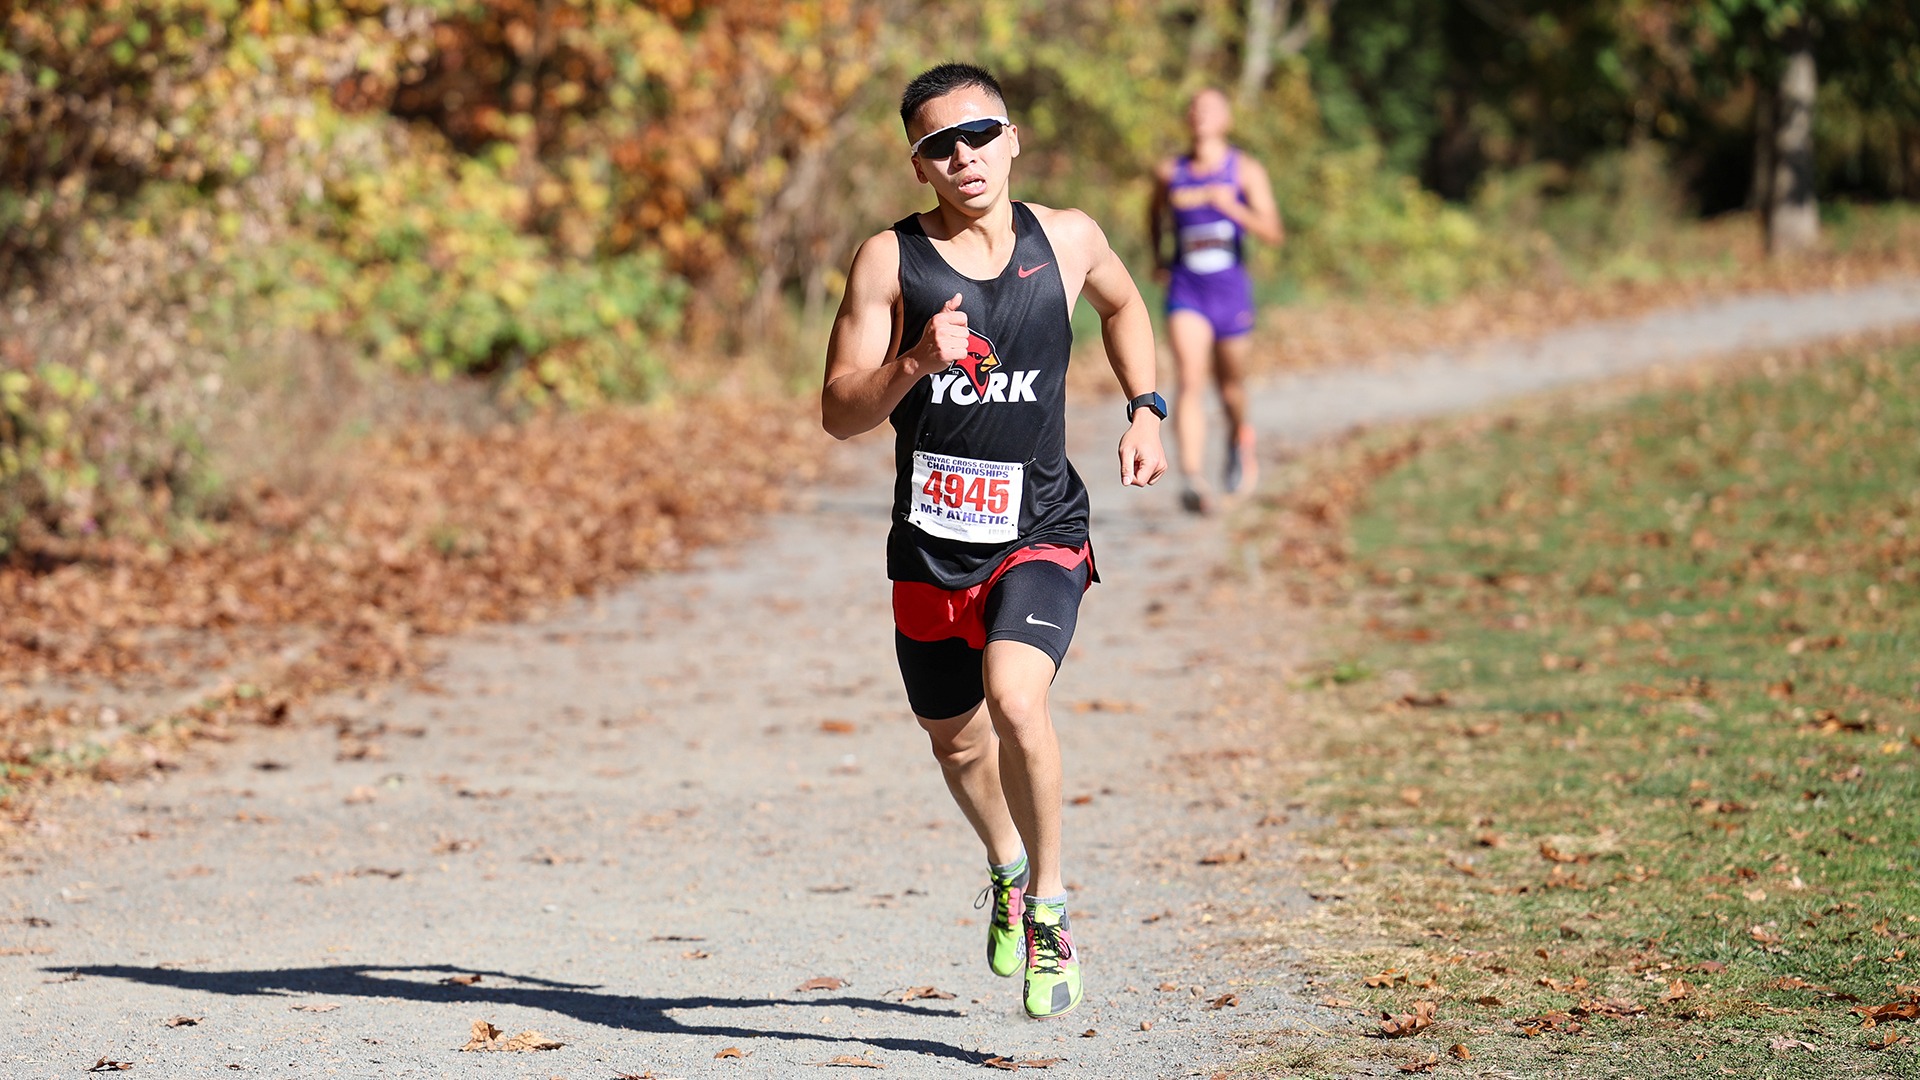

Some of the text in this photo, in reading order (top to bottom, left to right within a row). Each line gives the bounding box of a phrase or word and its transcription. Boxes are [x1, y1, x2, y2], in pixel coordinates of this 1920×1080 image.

[929, 369, 1041, 406] YORK
[922, 453, 1015, 471] CUNYAC CROSS COUNTRY
[927, 461, 1009, 478] CHAMPIONSHIPS
[923, 470, 1010, 514] 4945
[920, 503, 1009, 525] M-F ATHLETIC
